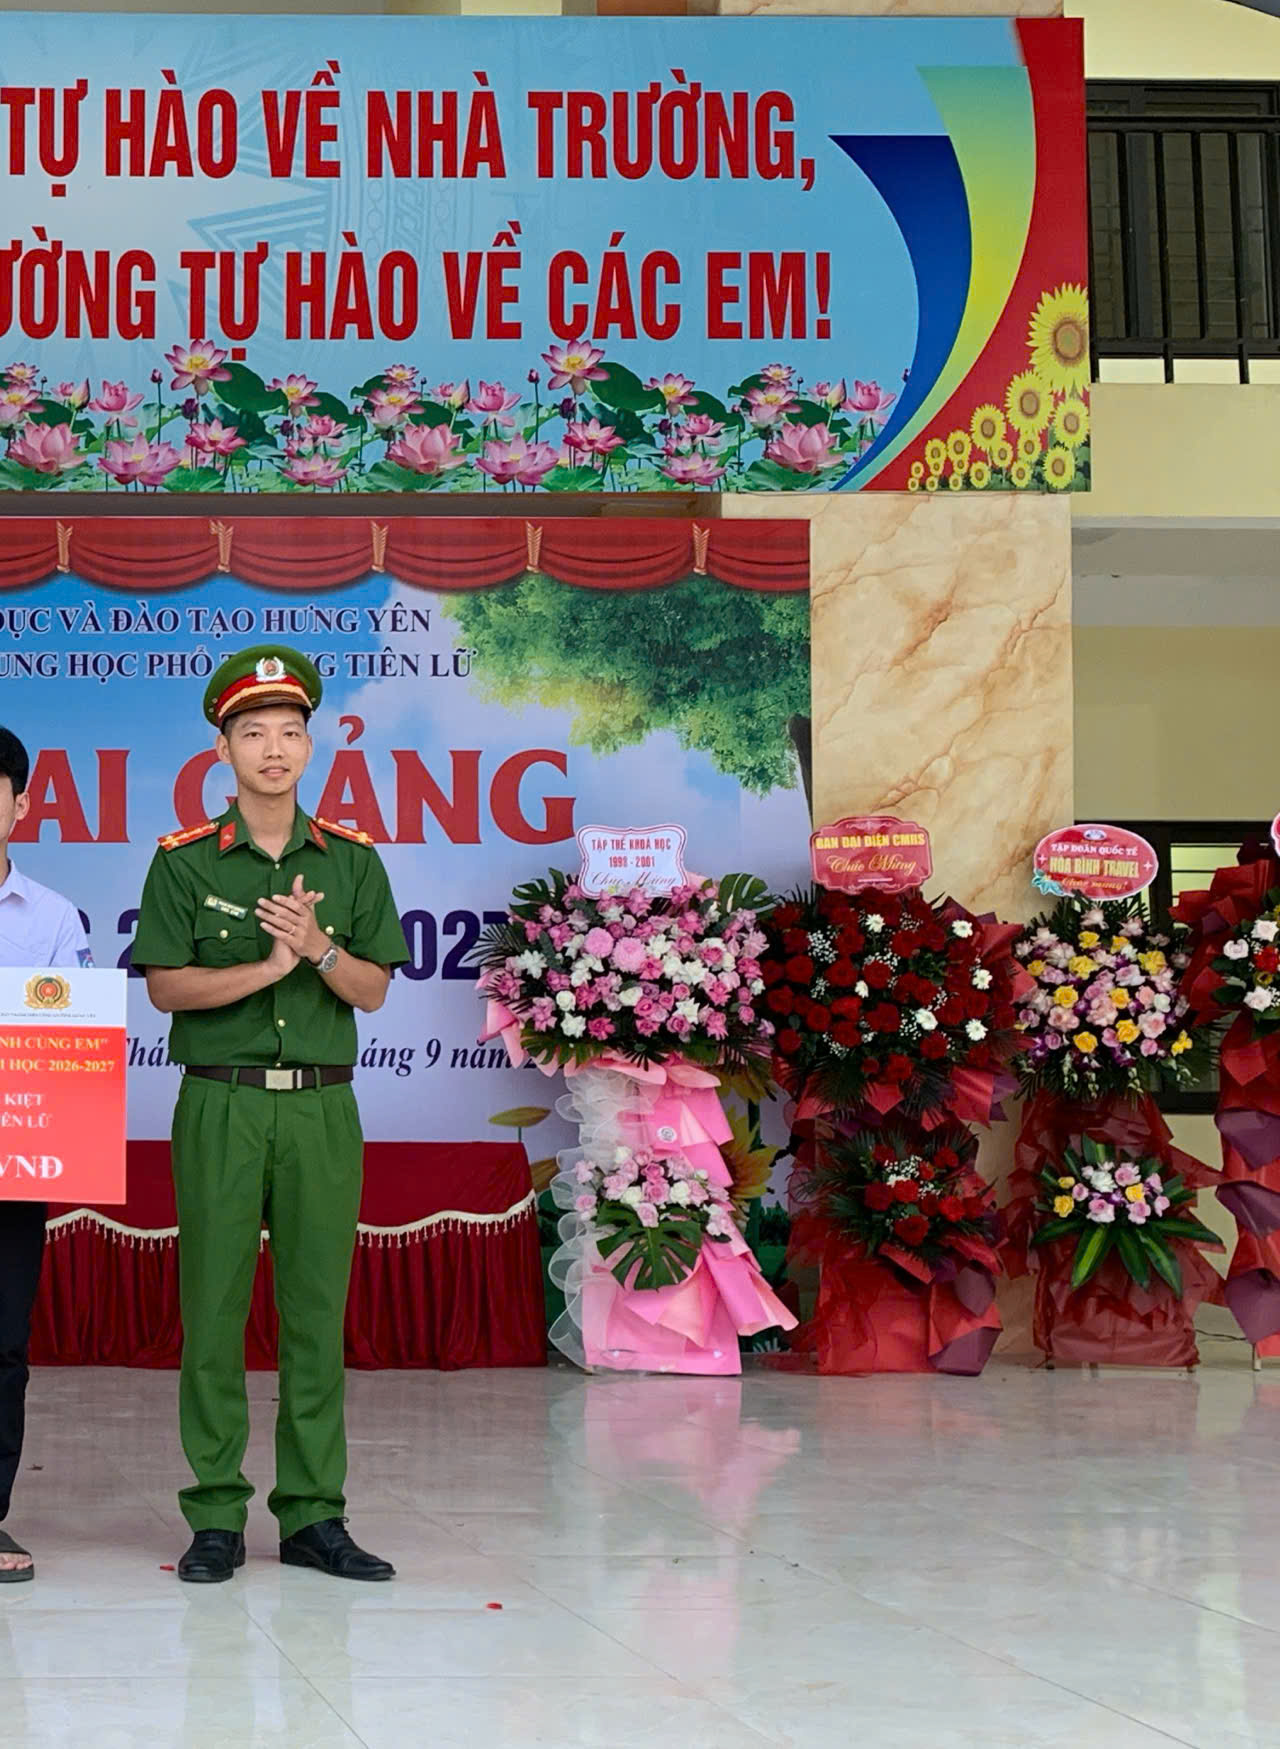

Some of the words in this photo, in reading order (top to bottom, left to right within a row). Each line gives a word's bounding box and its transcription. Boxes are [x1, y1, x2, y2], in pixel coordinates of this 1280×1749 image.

[0, 79, 89, 197] TỰ
[105, 69, 239, 179] HÀO
[262, 59, 342, 179] VỀ
[367, 72, 506, 179] NHÀ
[527, 69, 816, 191] TRƯỜNG,
[181, 243, 269, 361] TỰ
[284, 232, 419, 341] HÀO
[443, 221, 522, 341] VỀ
[548, 231, 681, 341] CÁC
[706, 252, 831, 340] EM!
[58, 603, 102, 632] VÀ
[111, 603, 180, 632] ĐÀO
[186, 609, 254, 638] TẠO
[264, 605, 359, 632] HƯNG
[368, 602, 431, 632] YÊN
[69, 654, 137, 683] HỌC
[148, 645, 213, 677] PHỔ
[345, 647, 420, 677] TIÊN
[430, 648, 477, 677] LỮ
[173, 715, 576, 845] GẢNG
[592, 838, 607, 852] TẬP
[654, 838, 671, 852] HỌC
[816, 837, 839, 849] BAN
[1051, 843, 1069, 853] TẬP
[1071, 843, 1097, 854] ĐOÀN
[1098, 844, 1124, 856] QUỐC
[635, 856, 655, 868] 2001
[1103, 859, 1139, 878] TRAVEL
[25, 1034, 71, 1051] CÙNG
[425, 1038, 441, 1069] 9
[9, 1058, 45, 1074] HỌC
[48, 1060, 115, 1073] 2026-2027
[4, 1091, 44, 1110] KIỆT
